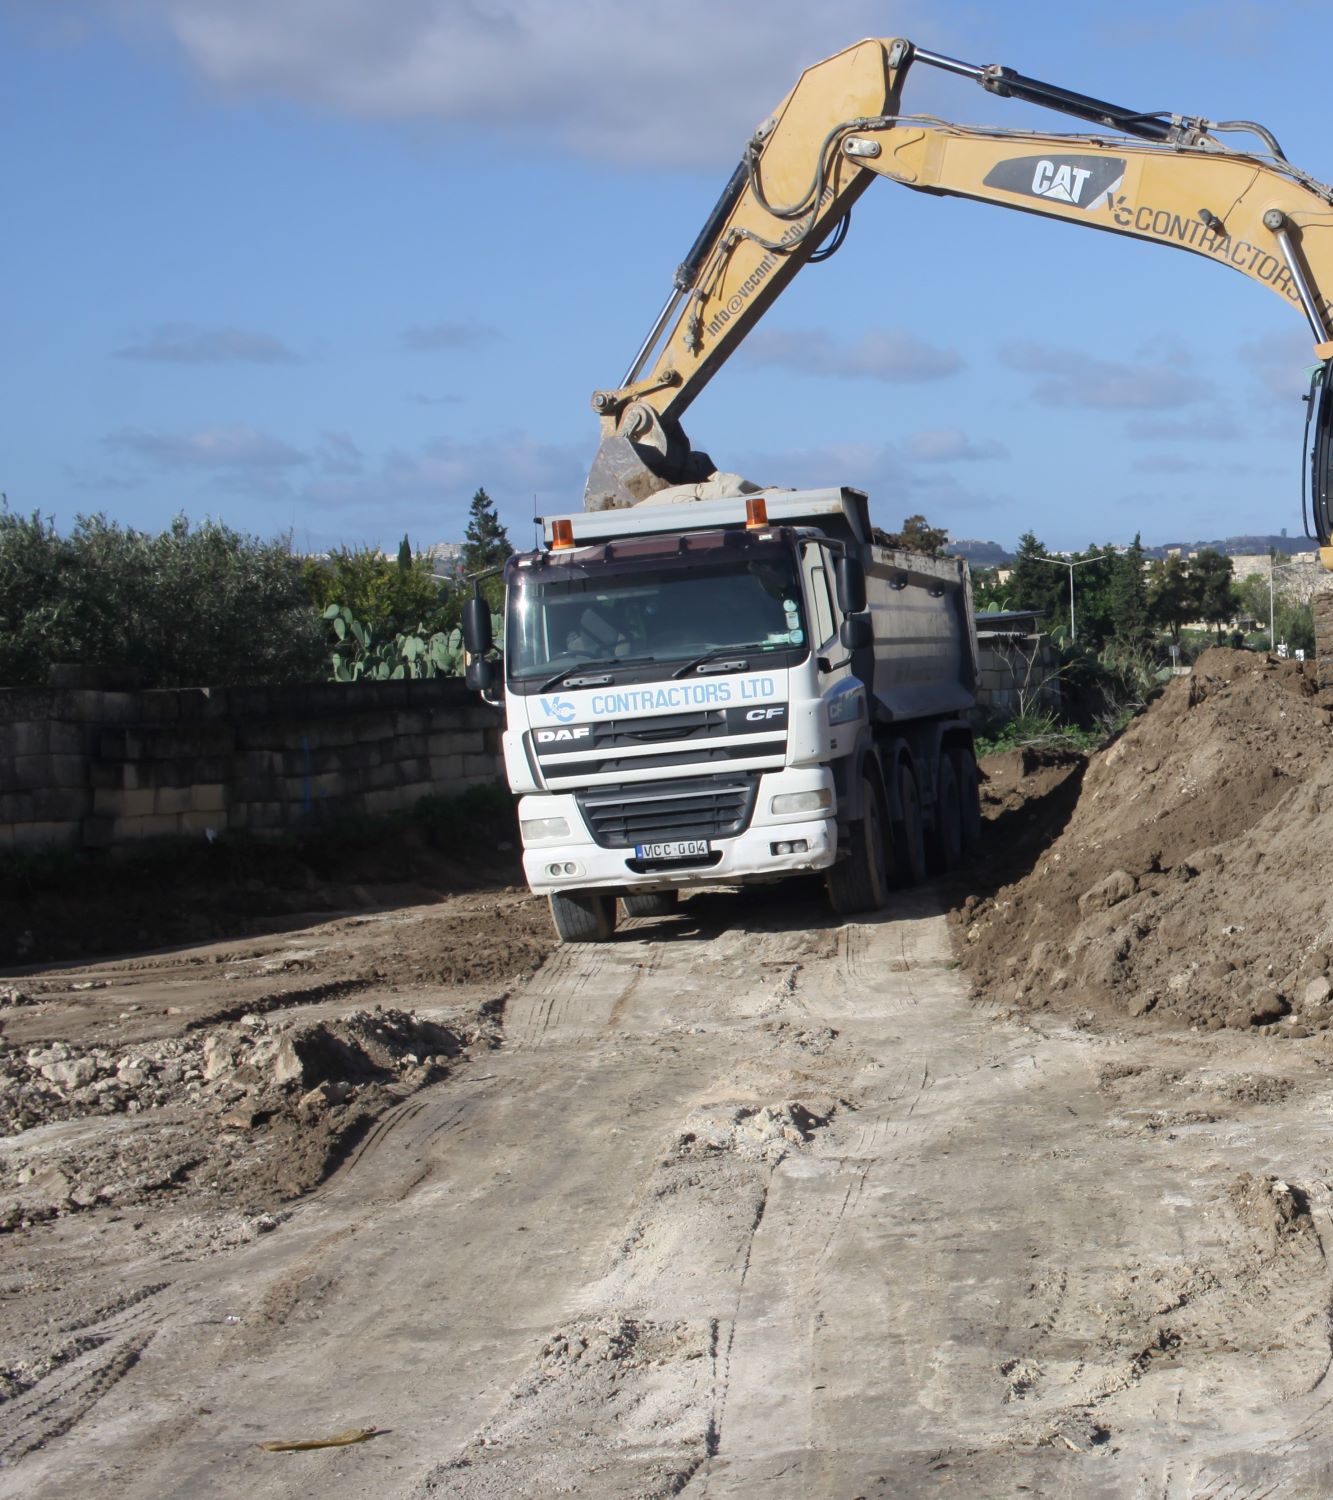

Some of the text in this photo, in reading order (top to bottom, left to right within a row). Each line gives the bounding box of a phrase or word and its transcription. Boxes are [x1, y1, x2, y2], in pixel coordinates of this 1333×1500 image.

[1032, 160, 1091, 203] CAT
[592, 682, 731, 714] CONTRACTORS
[741, 678, 775, 699] LTD
[746, 707, 785, 721] CF
[538, 727, 590, 743] DAF
[644, 843, 671, 857] VCC
